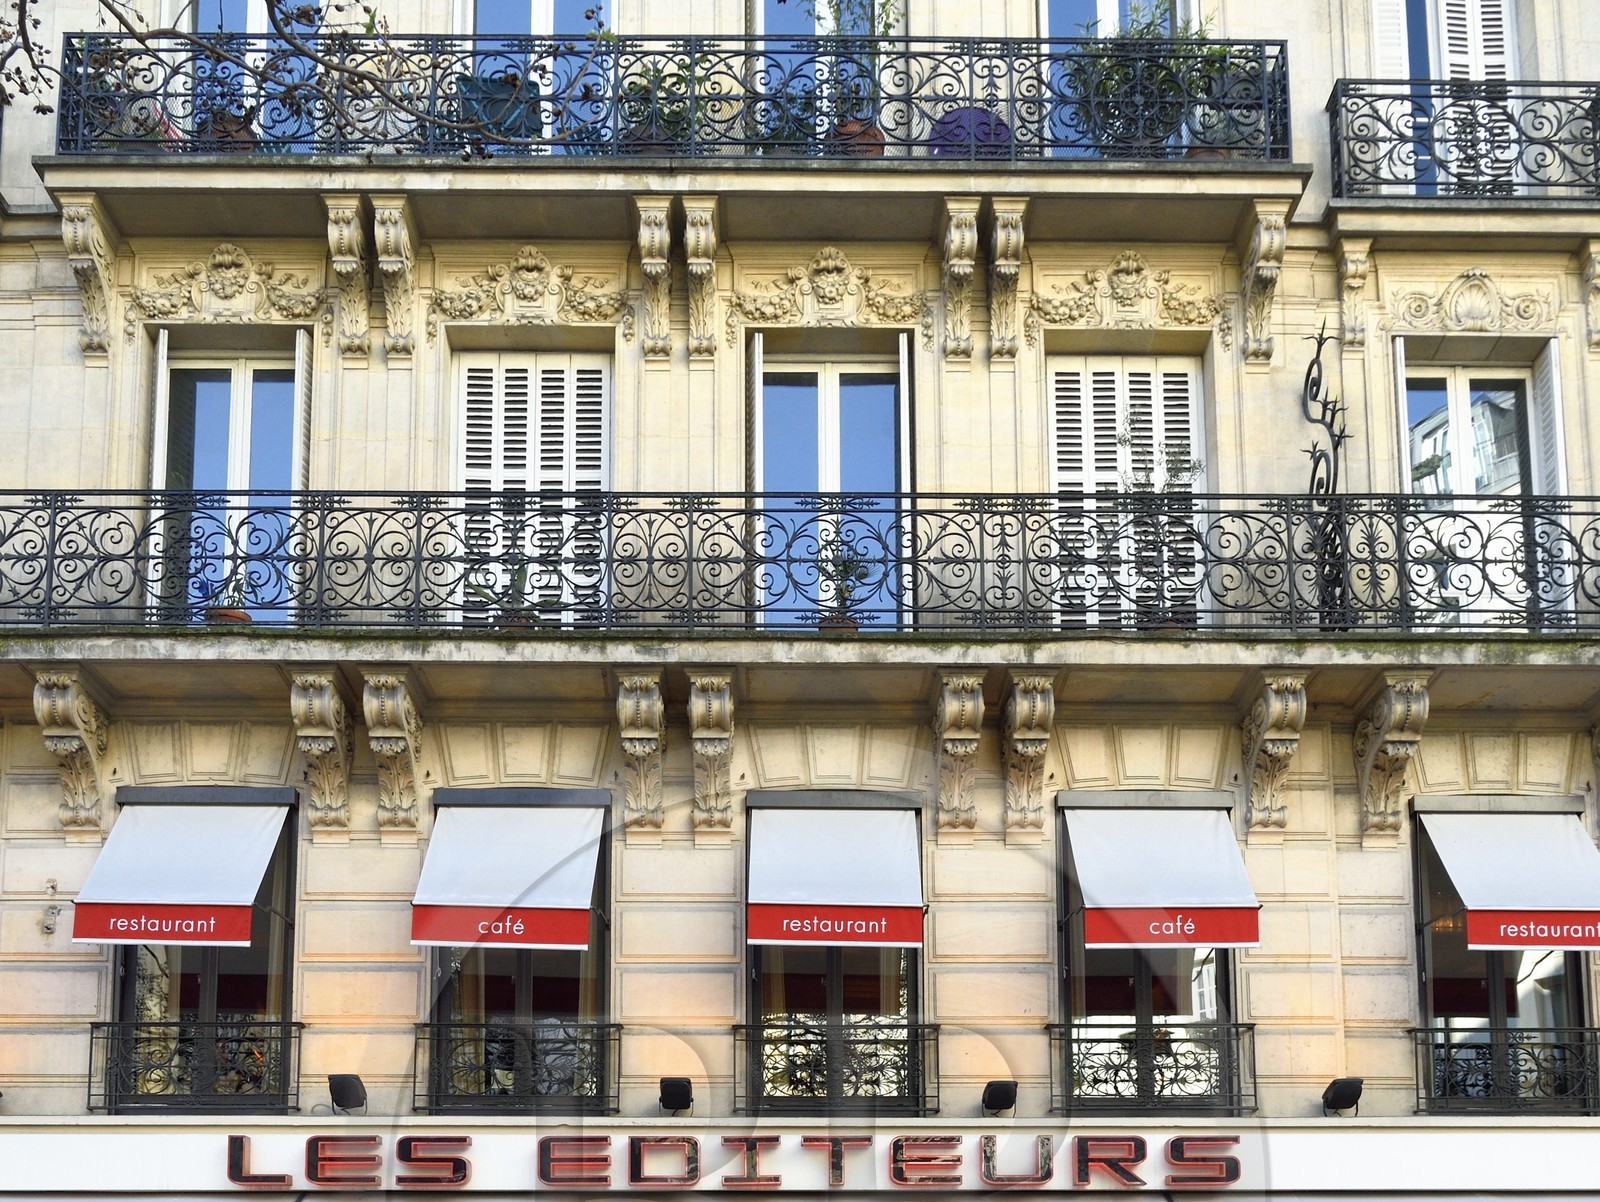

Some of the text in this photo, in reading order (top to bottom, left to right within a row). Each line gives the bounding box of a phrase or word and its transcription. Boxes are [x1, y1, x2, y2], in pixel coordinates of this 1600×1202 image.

[110, 915, 216, 932] restaurant
[478, 915, 525, 935] café
[783, 916, 887, 933] restaurant
[1149, 914, 1196, 935] café
[1500, 921, 1600, 938] restaurant
[227, 1135, 1241, 1187] LES EDITEURS
